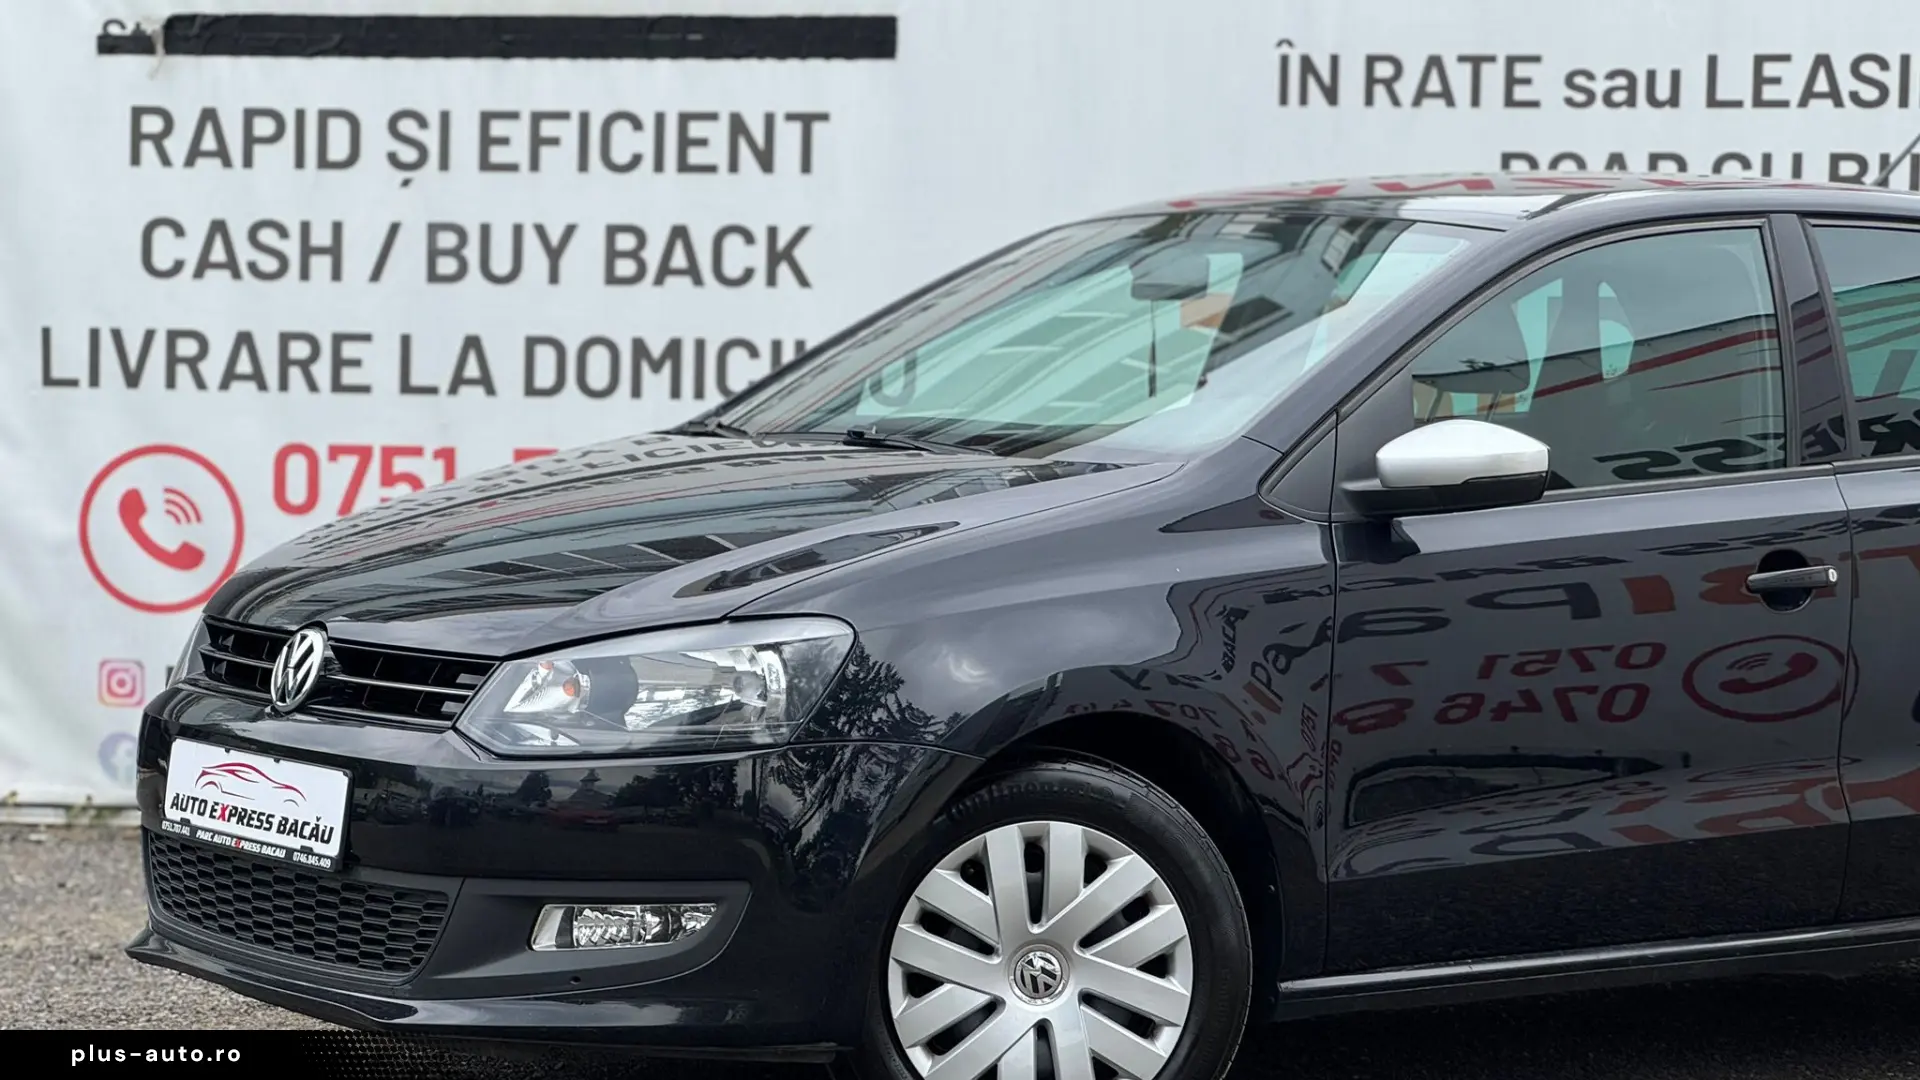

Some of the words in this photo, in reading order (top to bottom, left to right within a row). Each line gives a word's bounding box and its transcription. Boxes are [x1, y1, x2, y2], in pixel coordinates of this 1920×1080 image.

[1276, 38, 1340, 107] ÎN
[1364, 54, 1542, 109] RATE
[1563, 68, 1681, 109] sau
[1705, 53, 1920, 109] LEASI
[130, 105, 361, 170] RAPID
[386, 109, 450, 188] ȘI
[478, 110, 830, 175] EFICIENT
[141, 217, 343, 282] CASH
[368, 221, 402, 283] /
[426, 222, 577, 285] BUY
[604, 224, 811, 289] BACK
[41, 326, 373, 394] LIVRARE
[399, 333, 497, 397] LA
[169, 792, 208, 818] AUTO
[208, 803, 276, 832] EXPRESS
[276, 815, 335, 845] BACĂU
[196, 829, 213, 843] PARC
[213, 833, 232, 847] AUTO
[231, 837, 262, 854] EXPRESS
